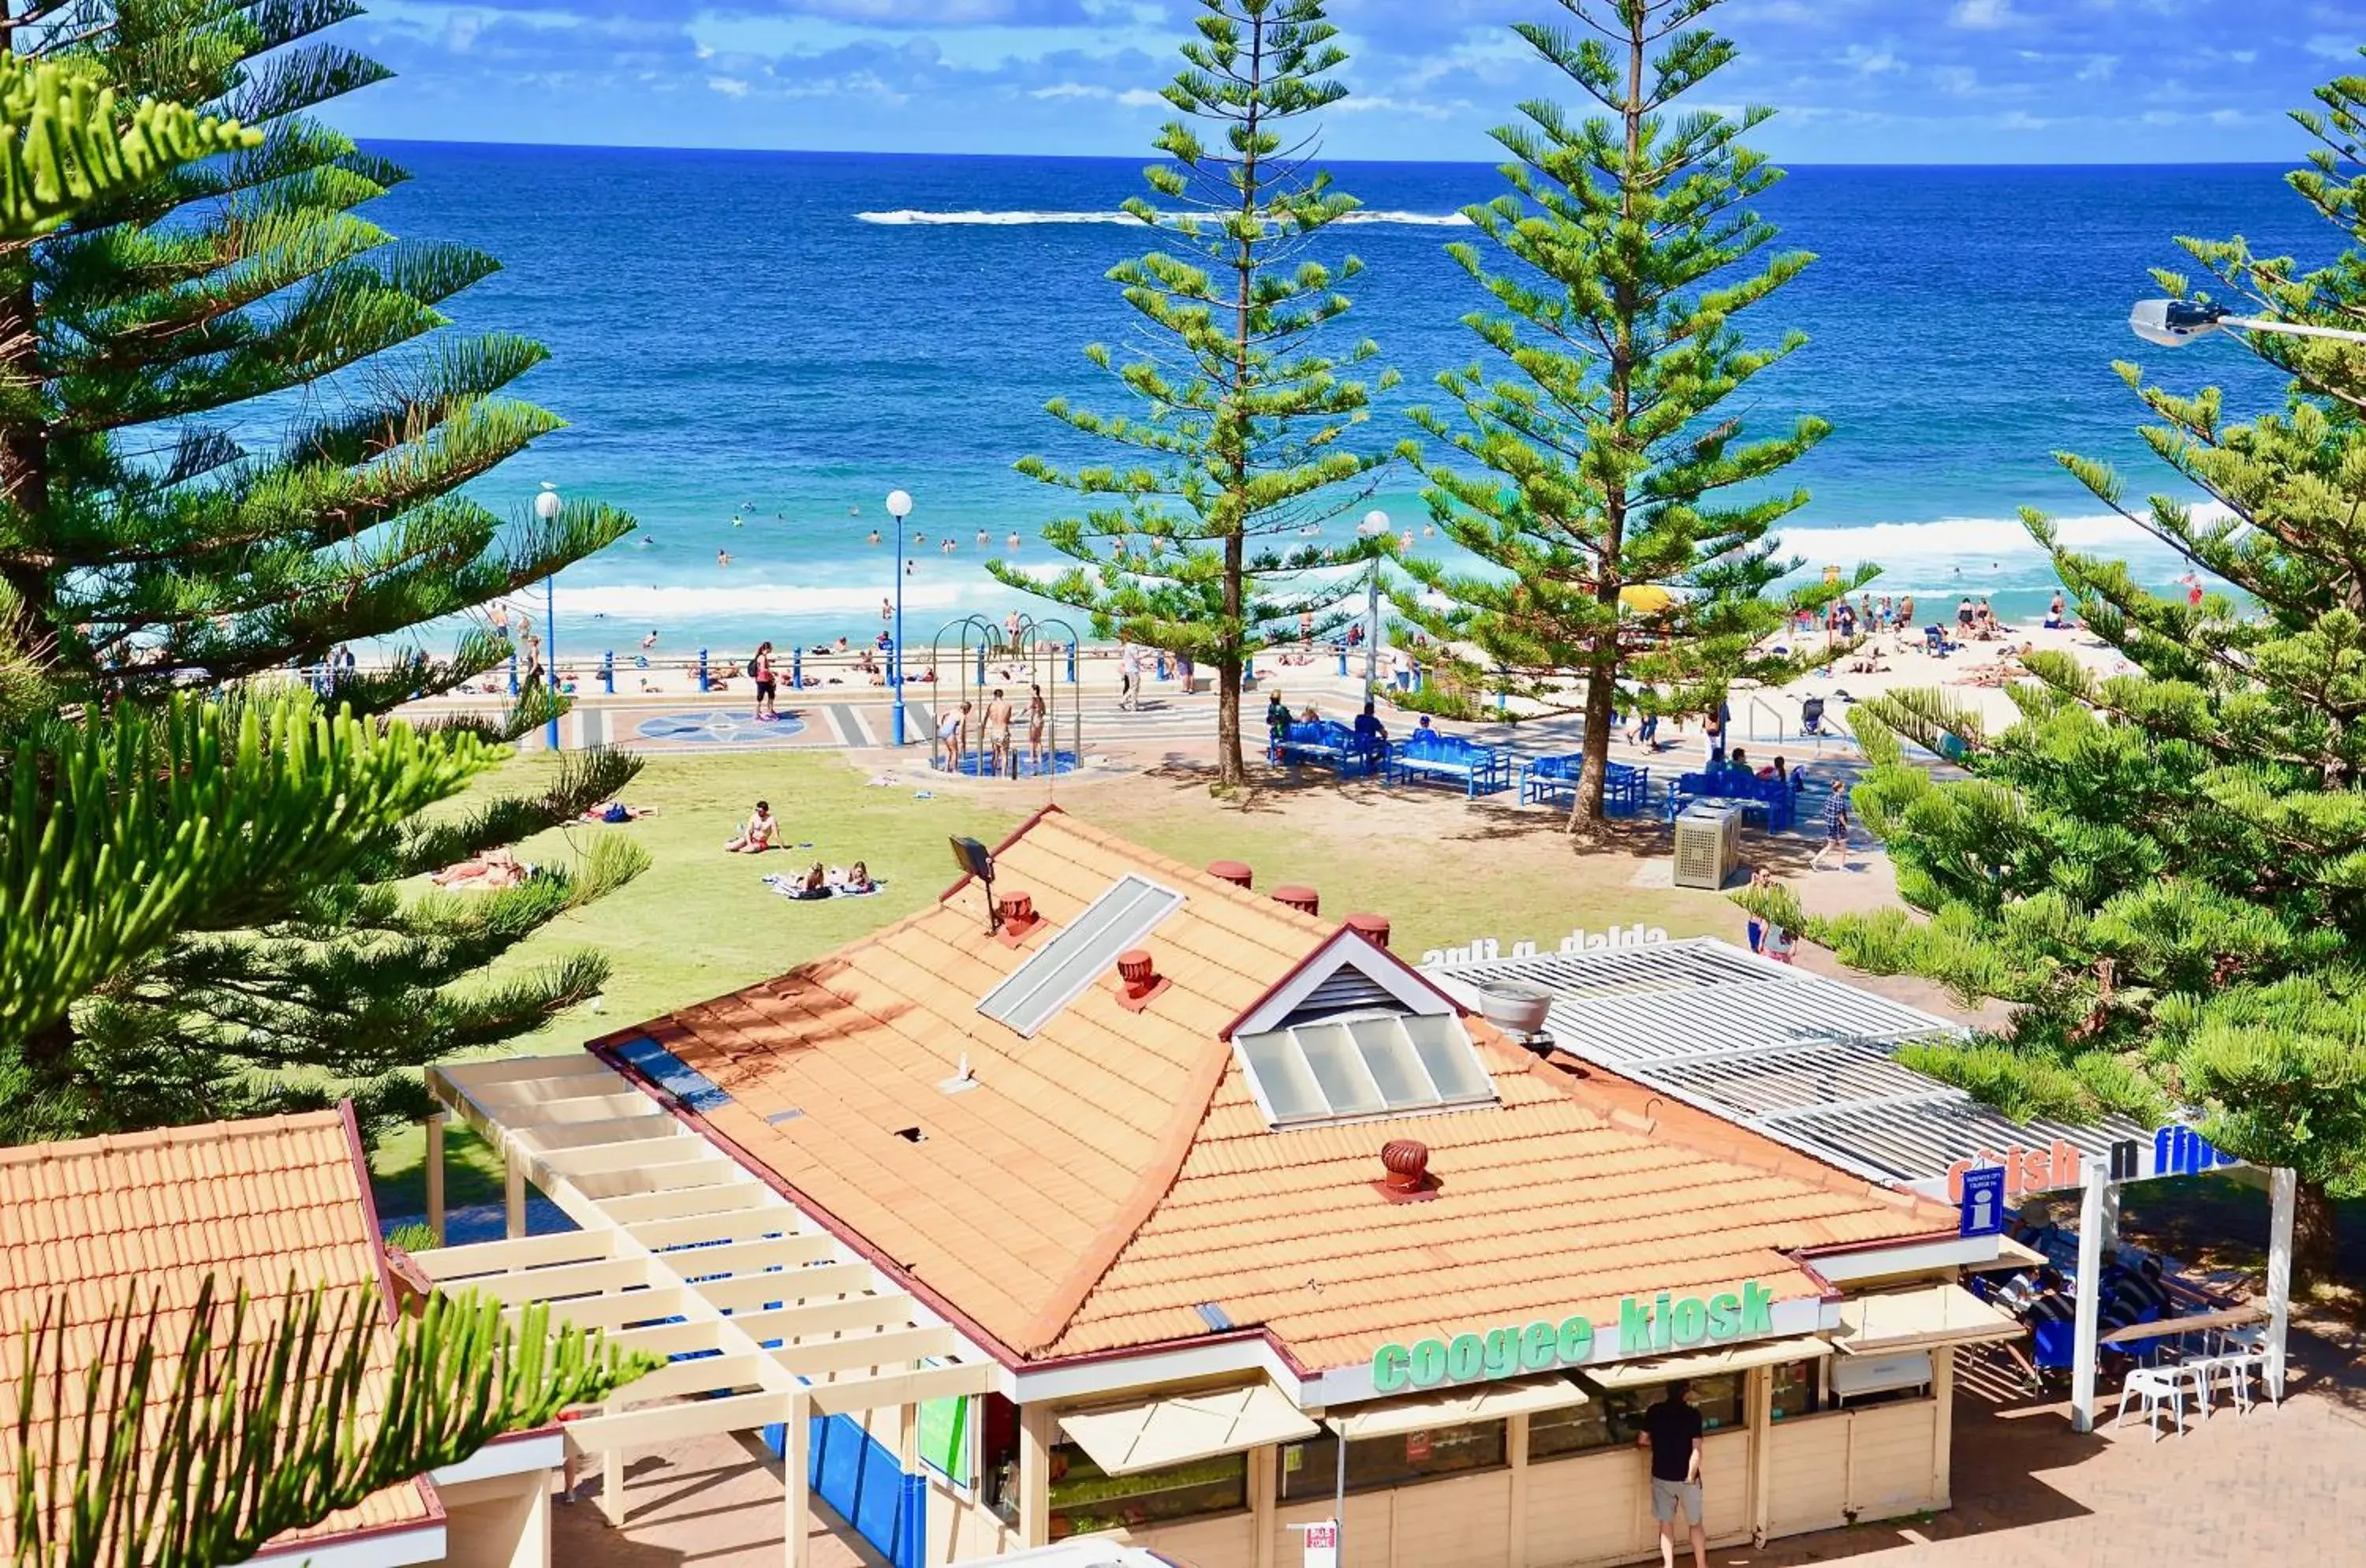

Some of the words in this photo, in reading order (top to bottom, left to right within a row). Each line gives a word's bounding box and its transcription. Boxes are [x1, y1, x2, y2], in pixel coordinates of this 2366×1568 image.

[2110, 1139, 2139, 1182] n
[1372, 1315, 1595, 1394] coogee
[1618, 1279, 1774, 1356] kiosk
